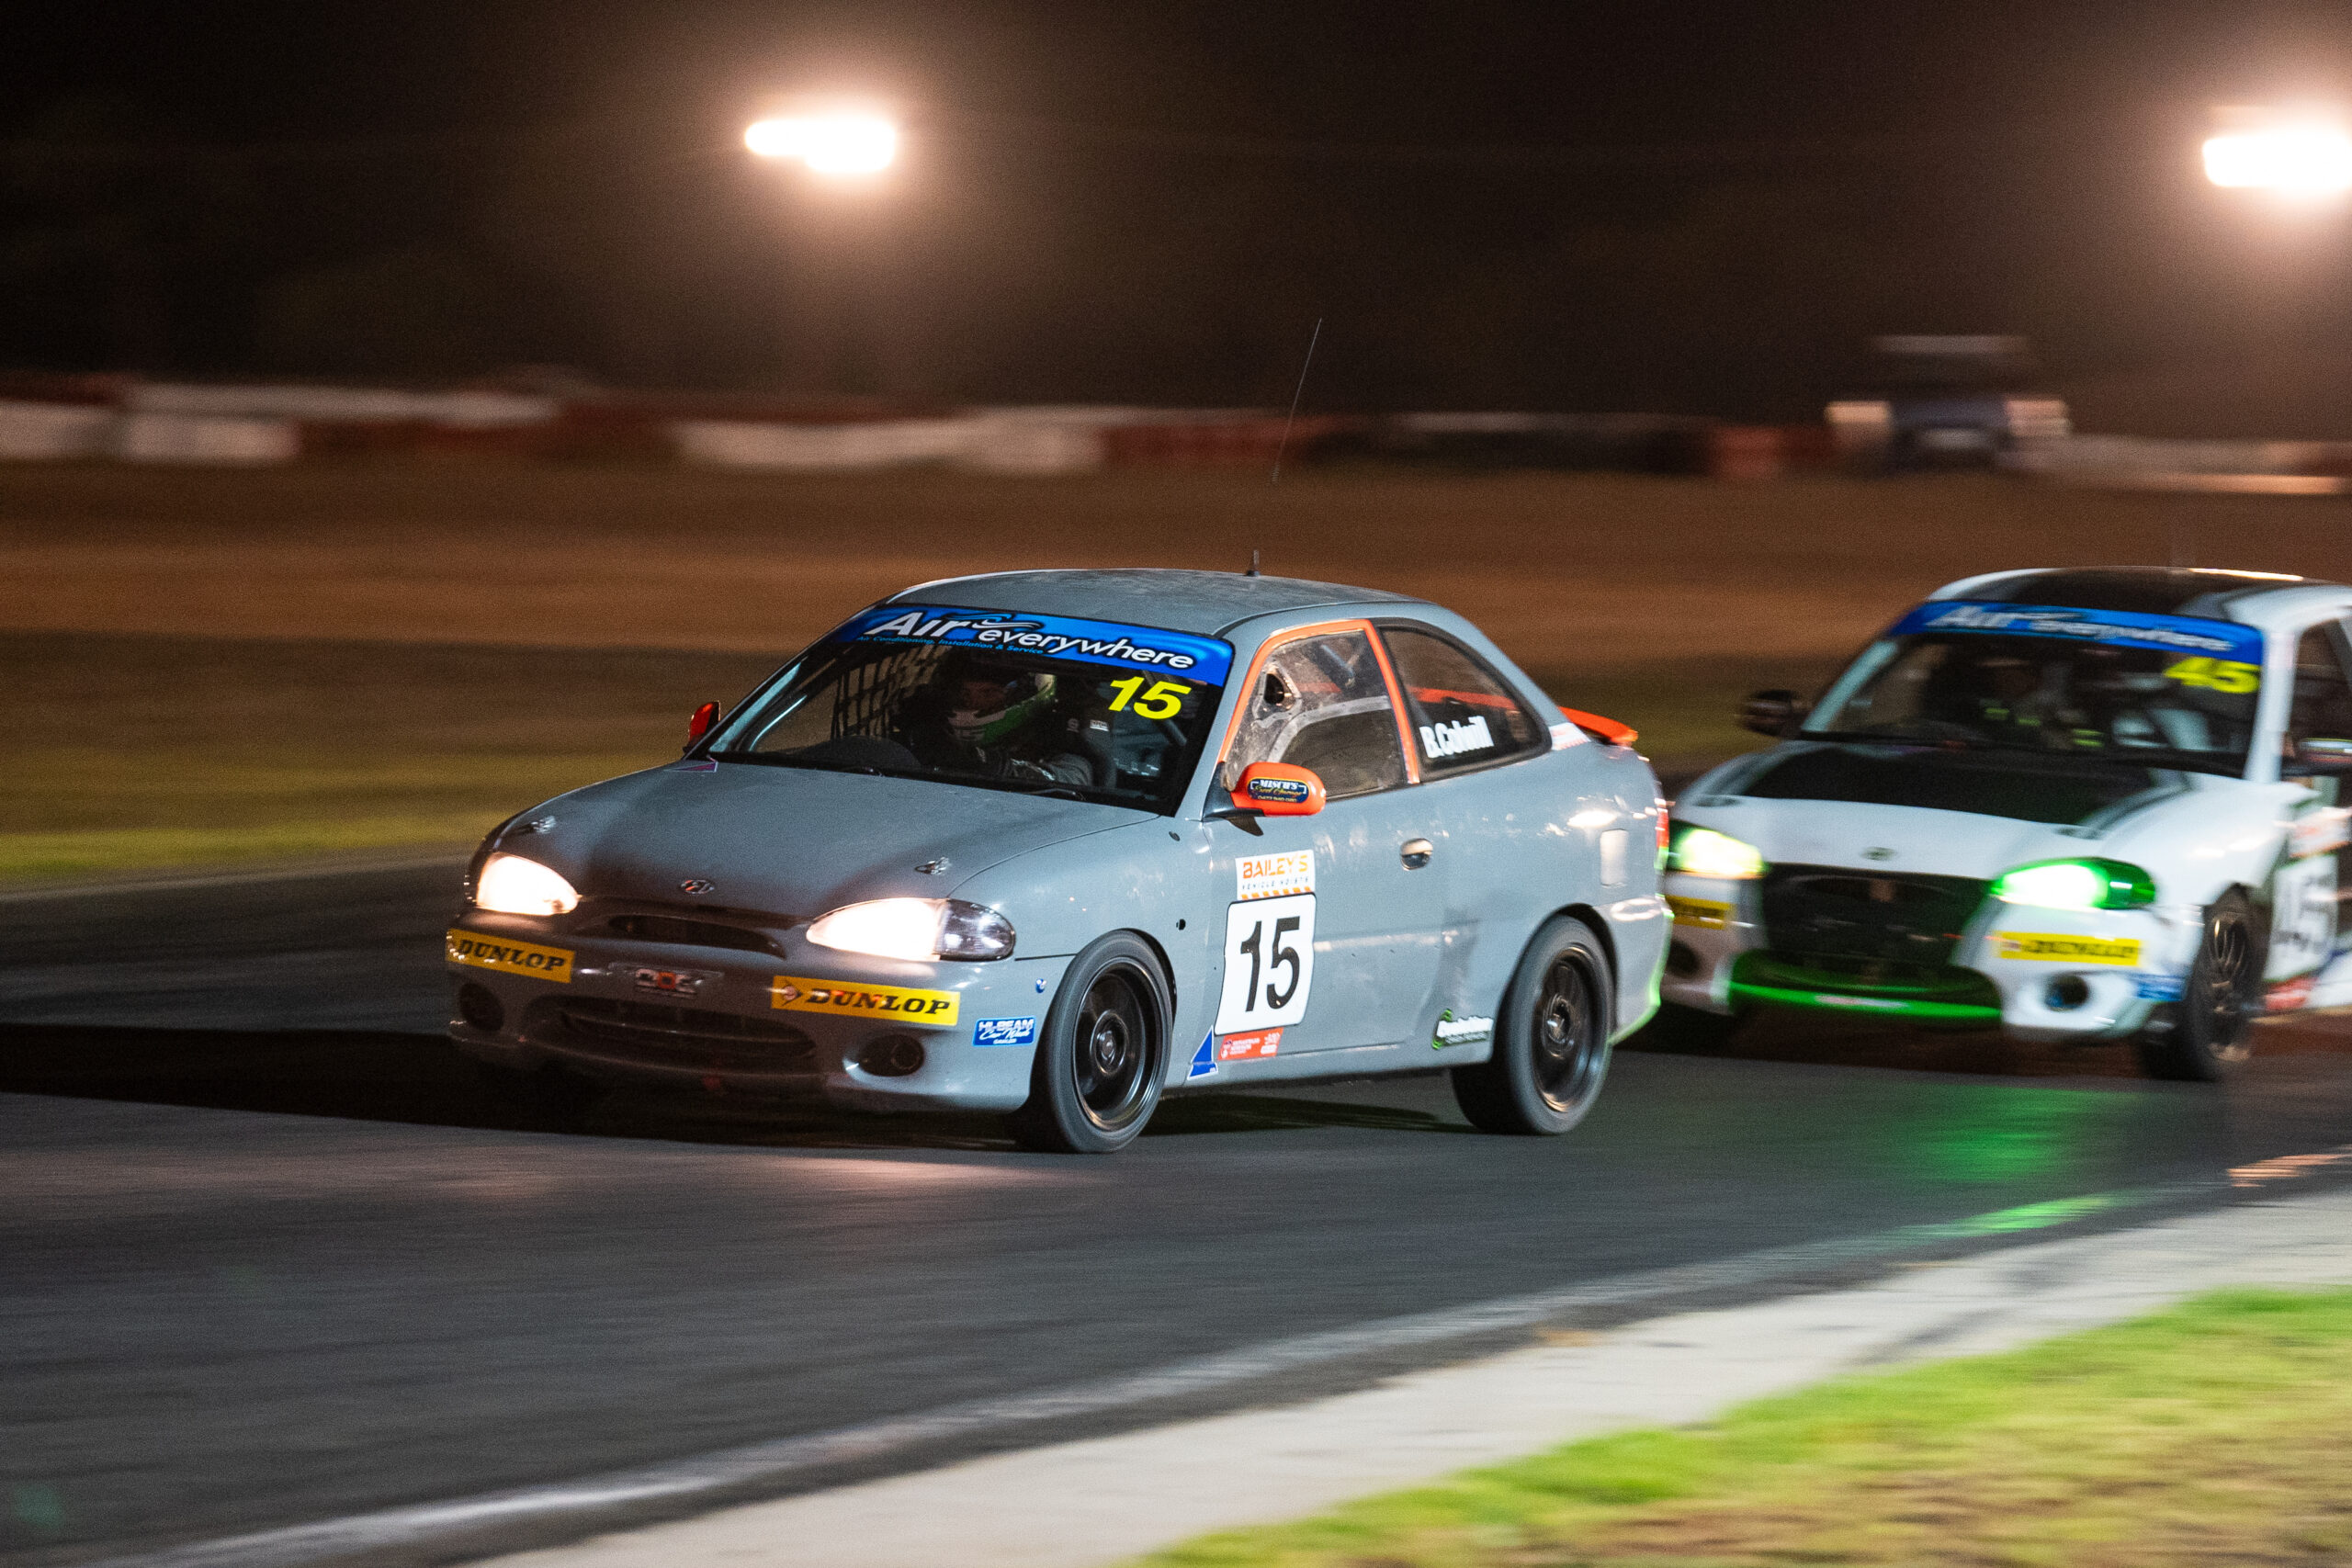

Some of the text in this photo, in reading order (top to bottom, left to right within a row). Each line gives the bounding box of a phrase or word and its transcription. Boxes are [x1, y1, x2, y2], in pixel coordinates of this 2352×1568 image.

[863, 612, 1194, 669] Air everywhere
[938, 639, 993, 649] Installation
[1007, 646, 1044, 654] Service
[2162, 656, 2261, 694] 45
[1108, 675, 1192, 719] 15
[458, 938, 566, 972] DUNLOP
[1240, 916, 1301, 1012] 15
[805, 987, 951, 1015] DUNLOP
